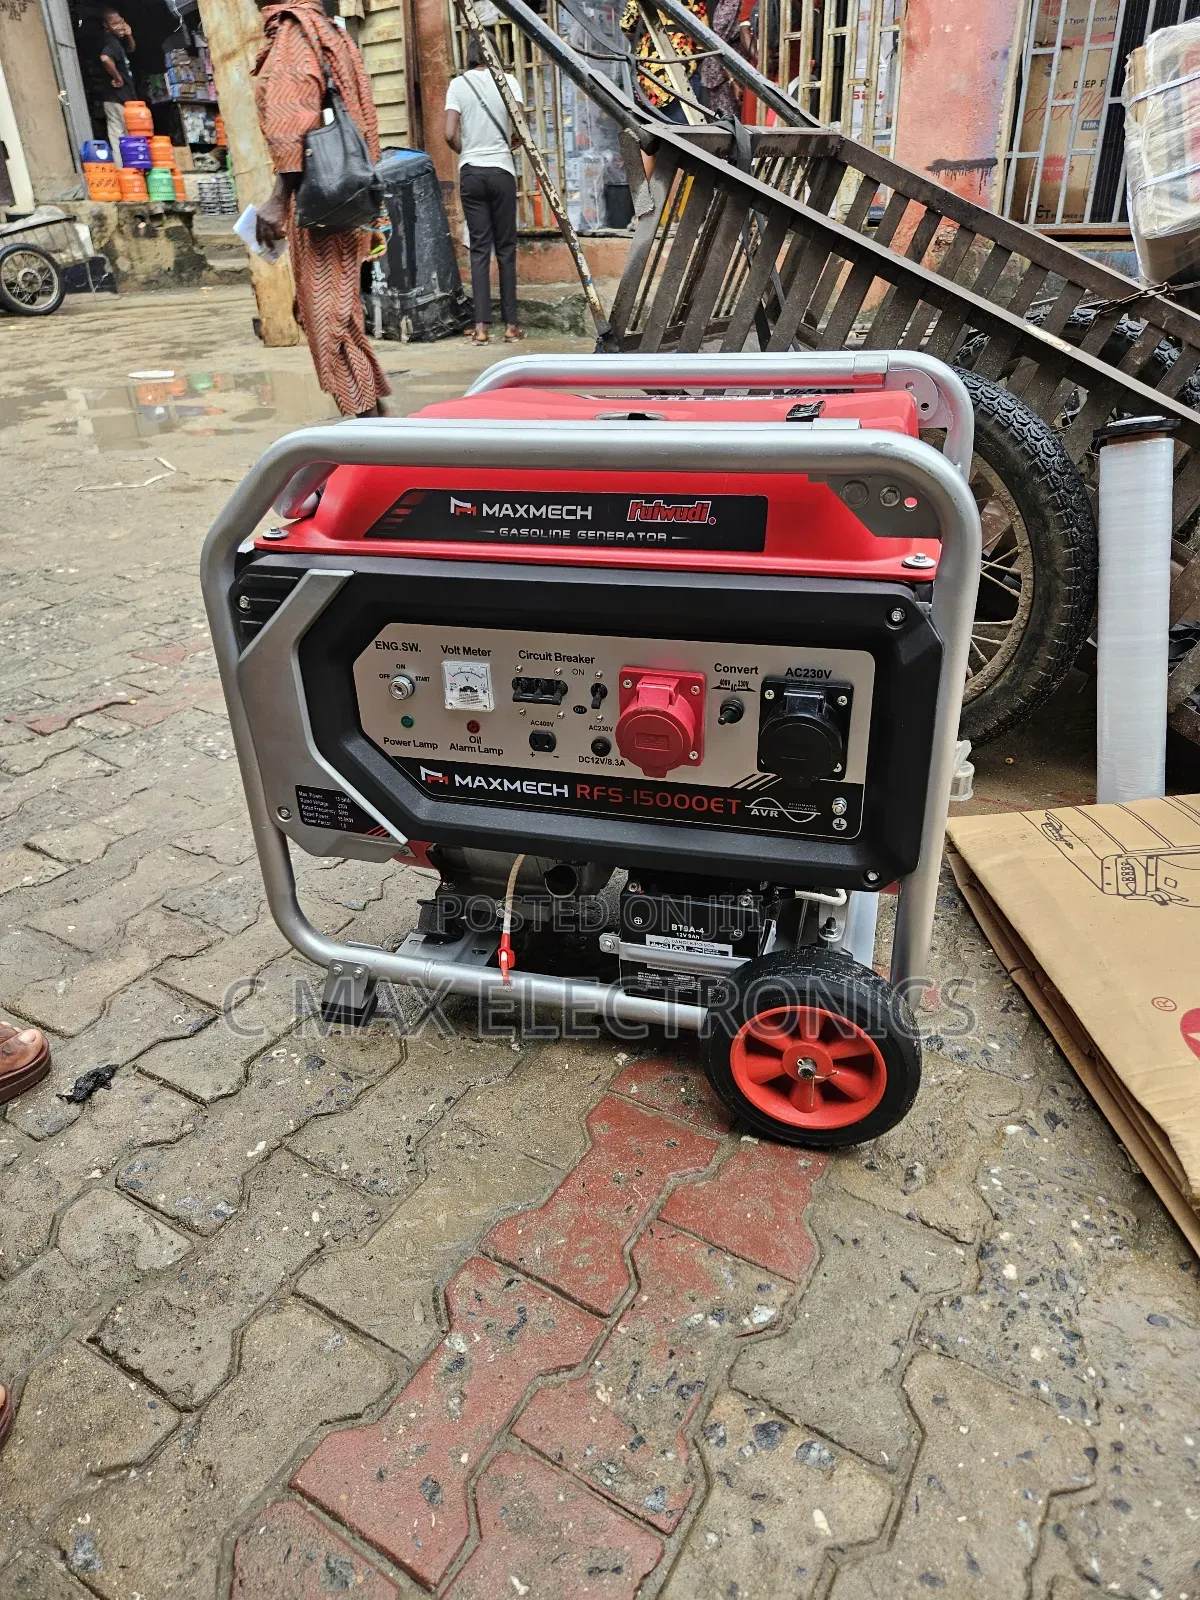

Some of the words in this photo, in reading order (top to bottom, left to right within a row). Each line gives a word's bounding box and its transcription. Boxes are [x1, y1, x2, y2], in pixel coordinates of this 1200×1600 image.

[1073, 79, 1097, 89] DEP
[482, 503, 593, 520] MAXMECH
[499, 527, 571, 539] GASOLINE
[577, 530, 667, 542] GENERATOR
[375, 640, 422, 653] ENG.SW.
[440, 644, 461, 656] Volt
[462, 646, 492, 657] Meter
[518, 649, 552, 662] Circuit
[554, 652, 596, 664] Breaker
[572, 668, 585, 676] ON
[713, 662, 759, 675] Convert
[784, 667, 833, 680] AC230V
[588, 724, 614, 732] AC230V
[383, 737, 411, 748] Power
[413, 740, 439, 750] Lamp
[468, 735, 482, 744] Oil
[449, 742, 476, 753] Alarm
[478, 745, 504, 756] Lamp
[578, 755, 626, 767] DC12V/8.3A
[454, 773, 569, 798] MAXMECH
[575, 783, 742, 815] RFS-15000ET
[750, 808, 779, 818] AVR
